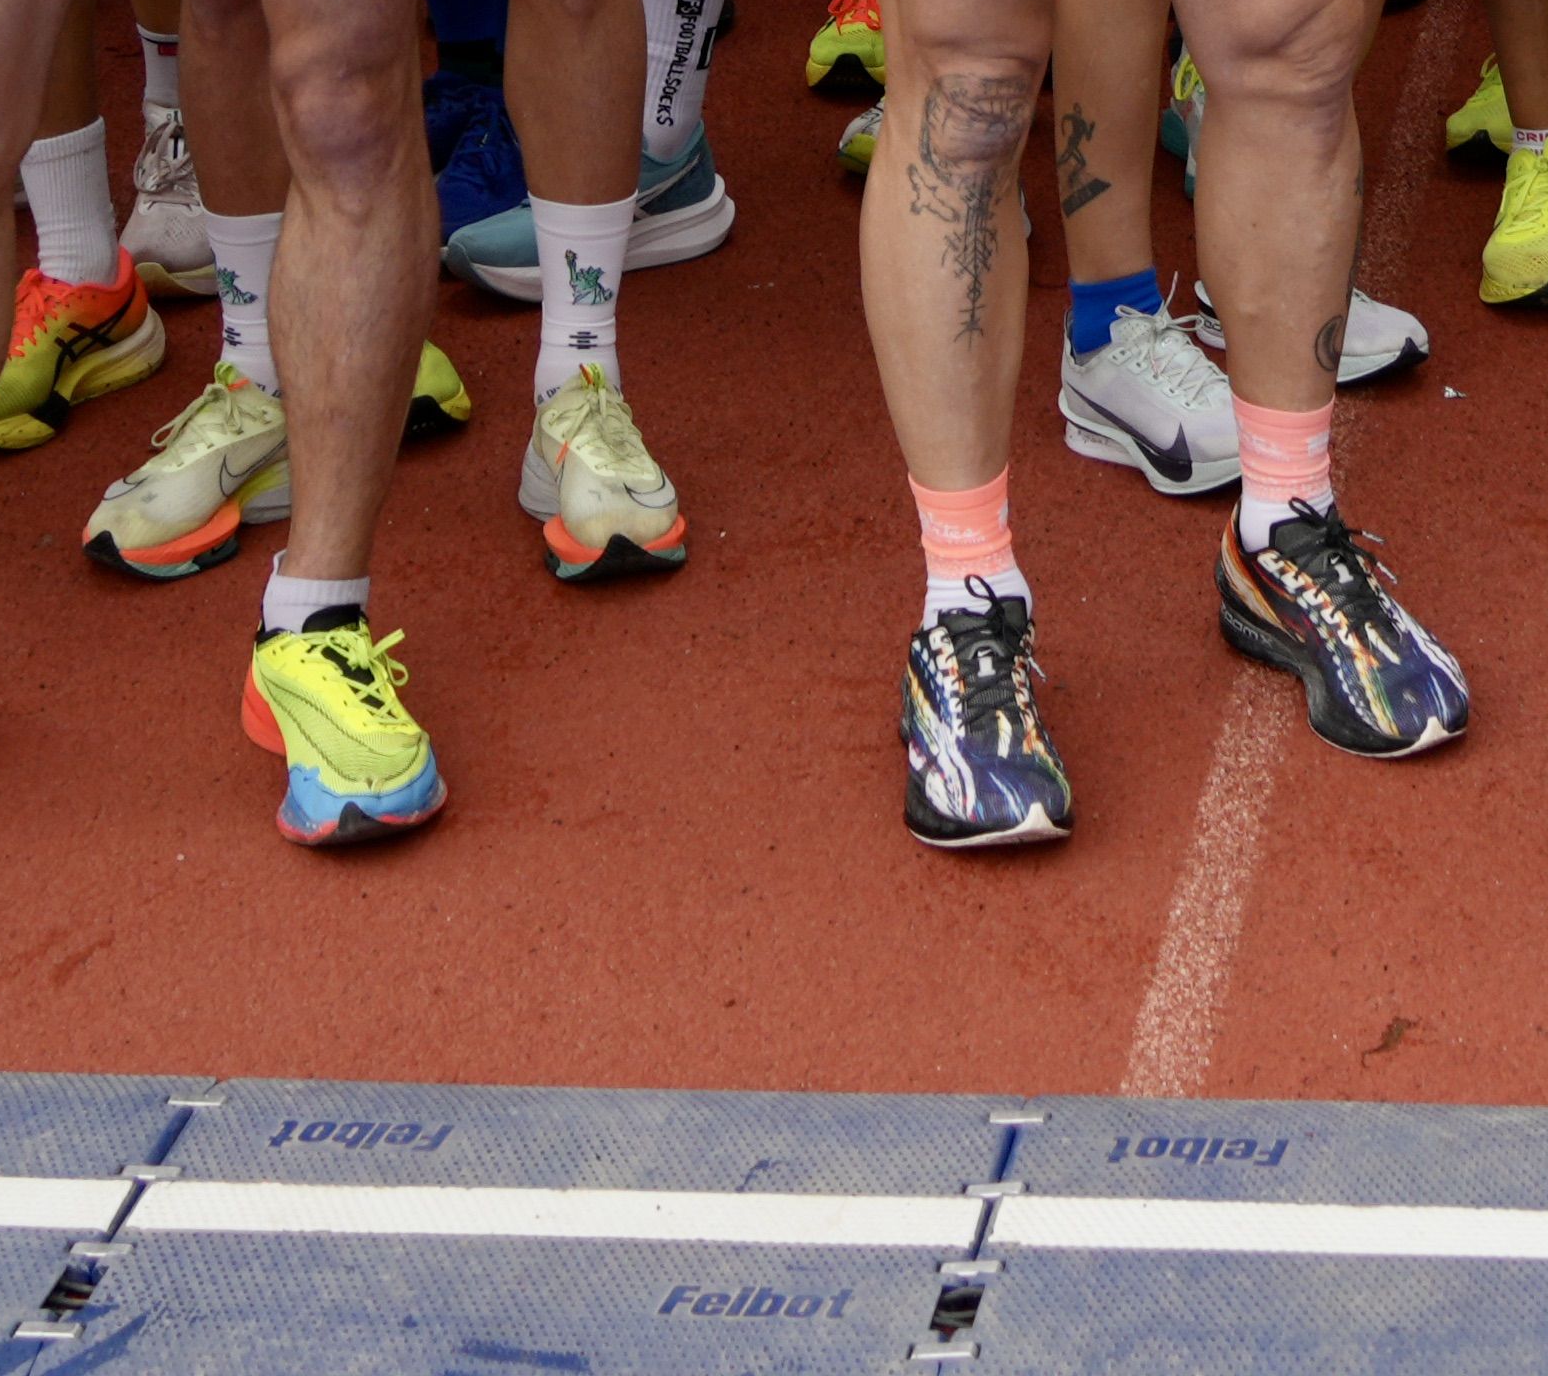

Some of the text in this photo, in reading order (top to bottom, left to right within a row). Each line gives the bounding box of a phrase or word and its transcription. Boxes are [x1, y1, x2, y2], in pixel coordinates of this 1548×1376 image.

[266, 1118, 454, 1150] Felbot
[1106, 1135, 1289, 1167] Felbot
[655, 1283, 854, 1320] Felbot
